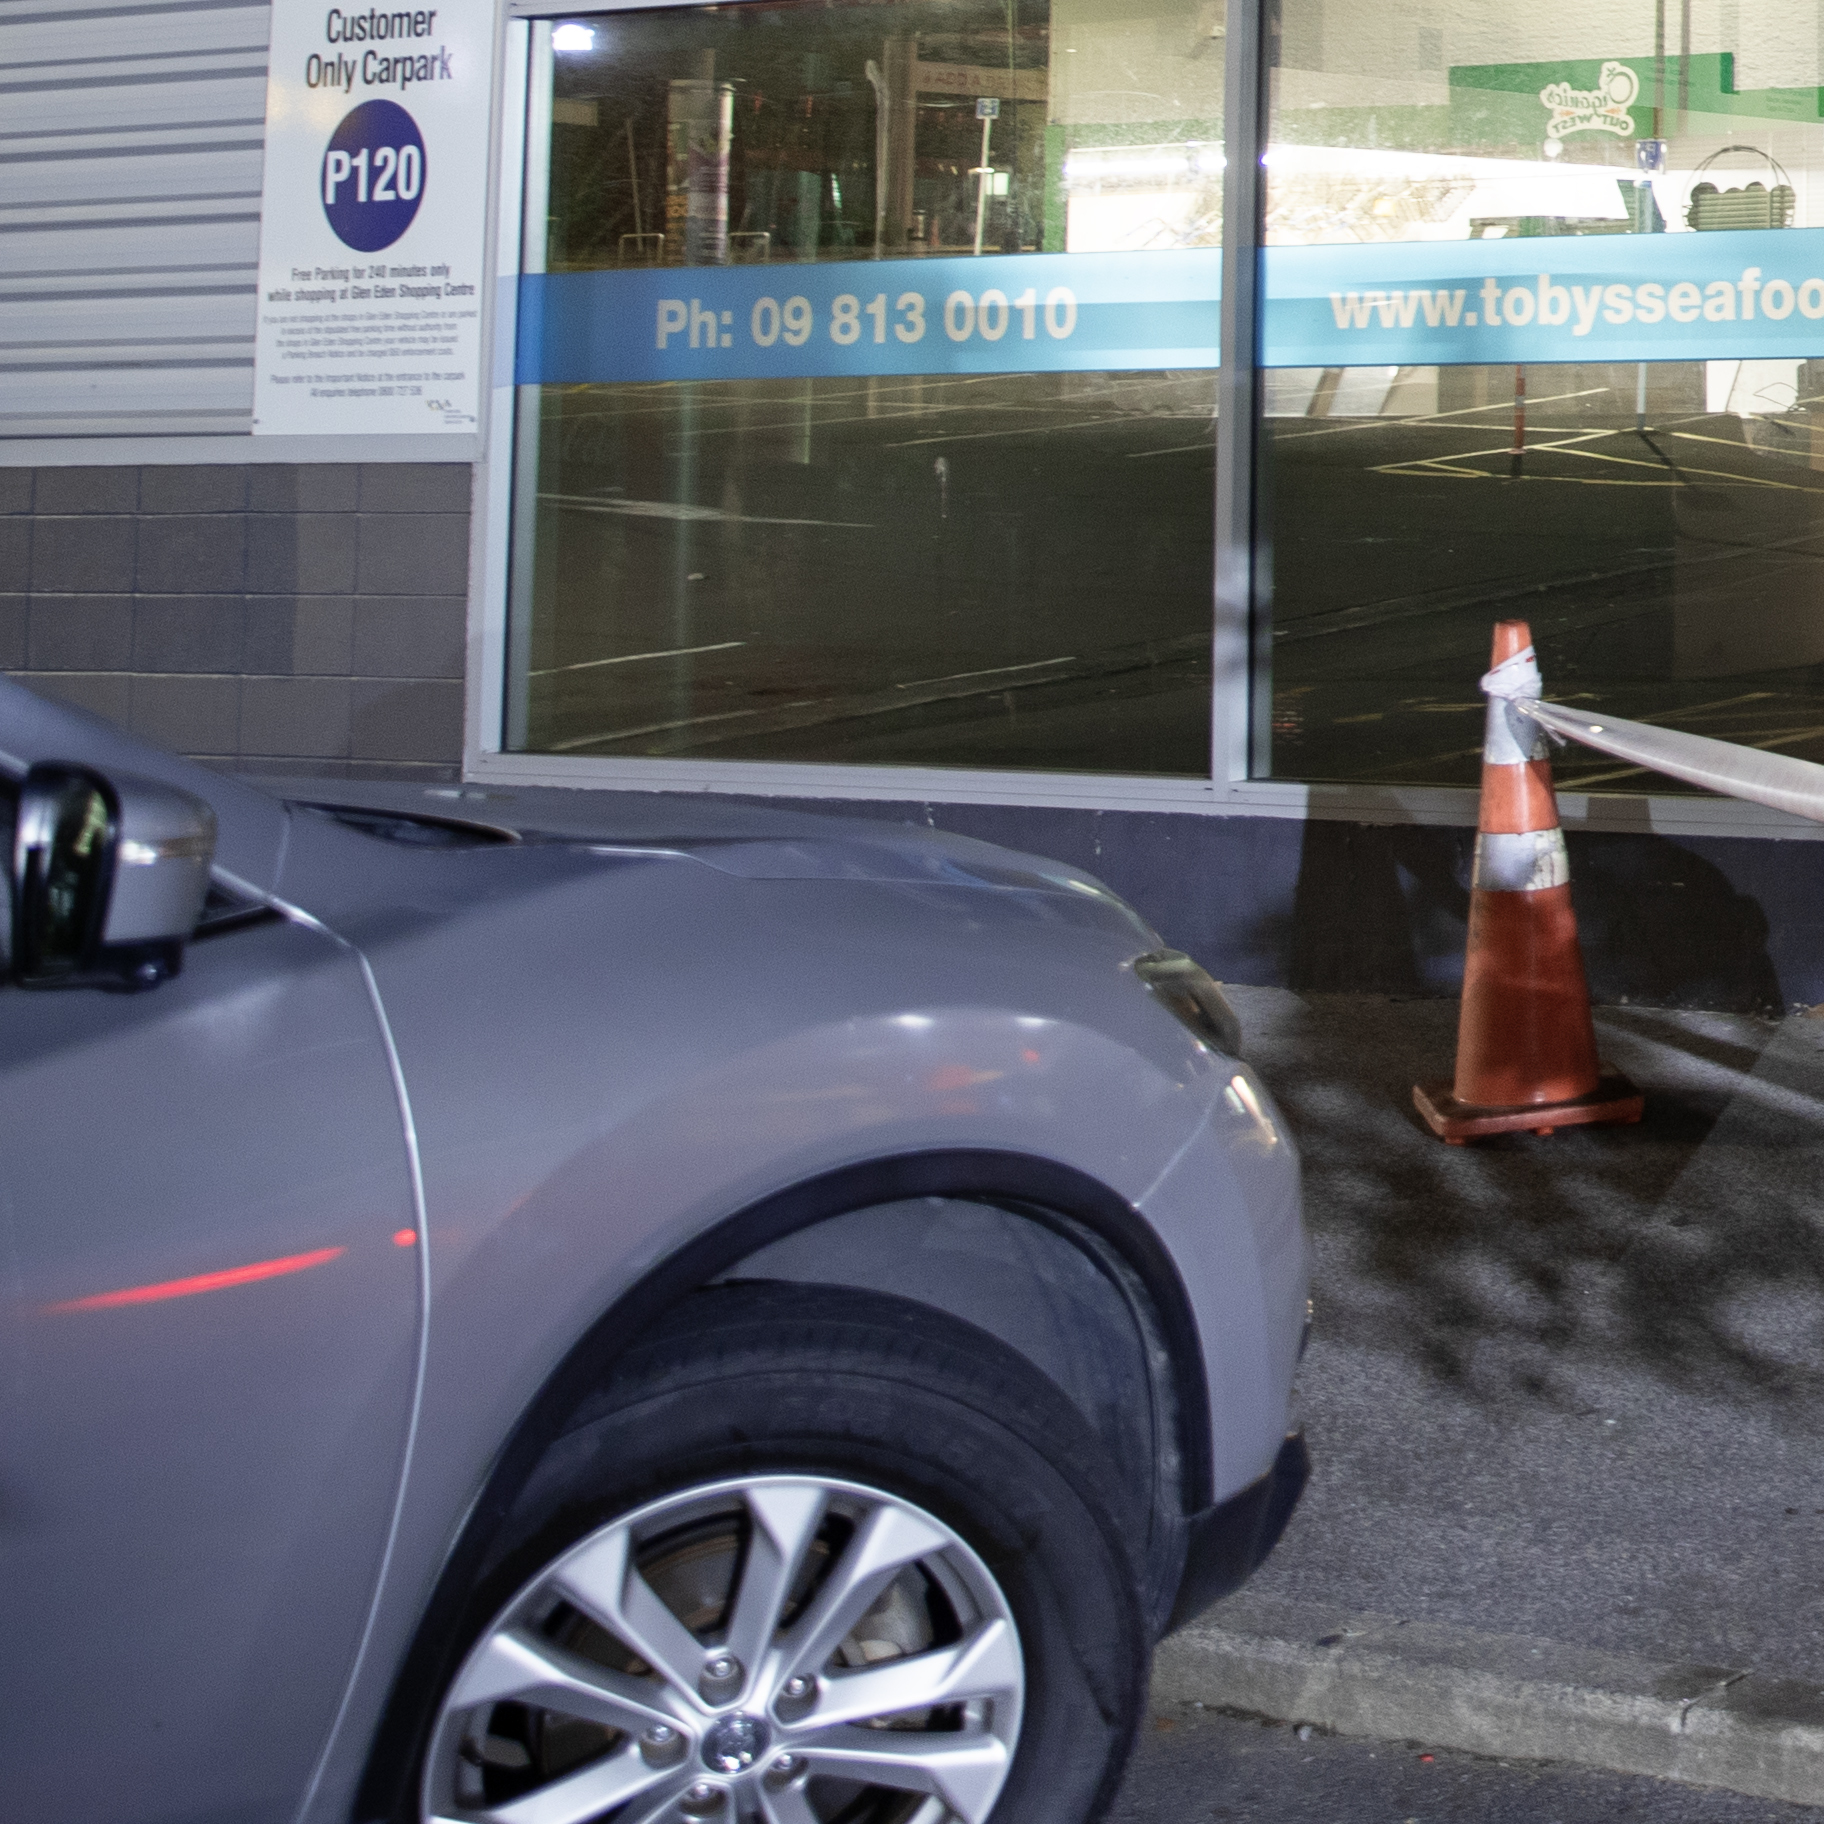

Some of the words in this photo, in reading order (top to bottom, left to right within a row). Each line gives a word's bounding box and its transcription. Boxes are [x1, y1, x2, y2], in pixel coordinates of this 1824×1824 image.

[326, 7, 437, 44] Customer
[306, 52, 357, 94] Only
[363, 45, 453, 91] Carpark
[325, 144, 422, 205] P120
[655, 298, 733, 350] Ph:
[750, 296, 814, 347] 09
[829, 292, 928, 344] 813
[943, 287, 1079, 341] 0010
